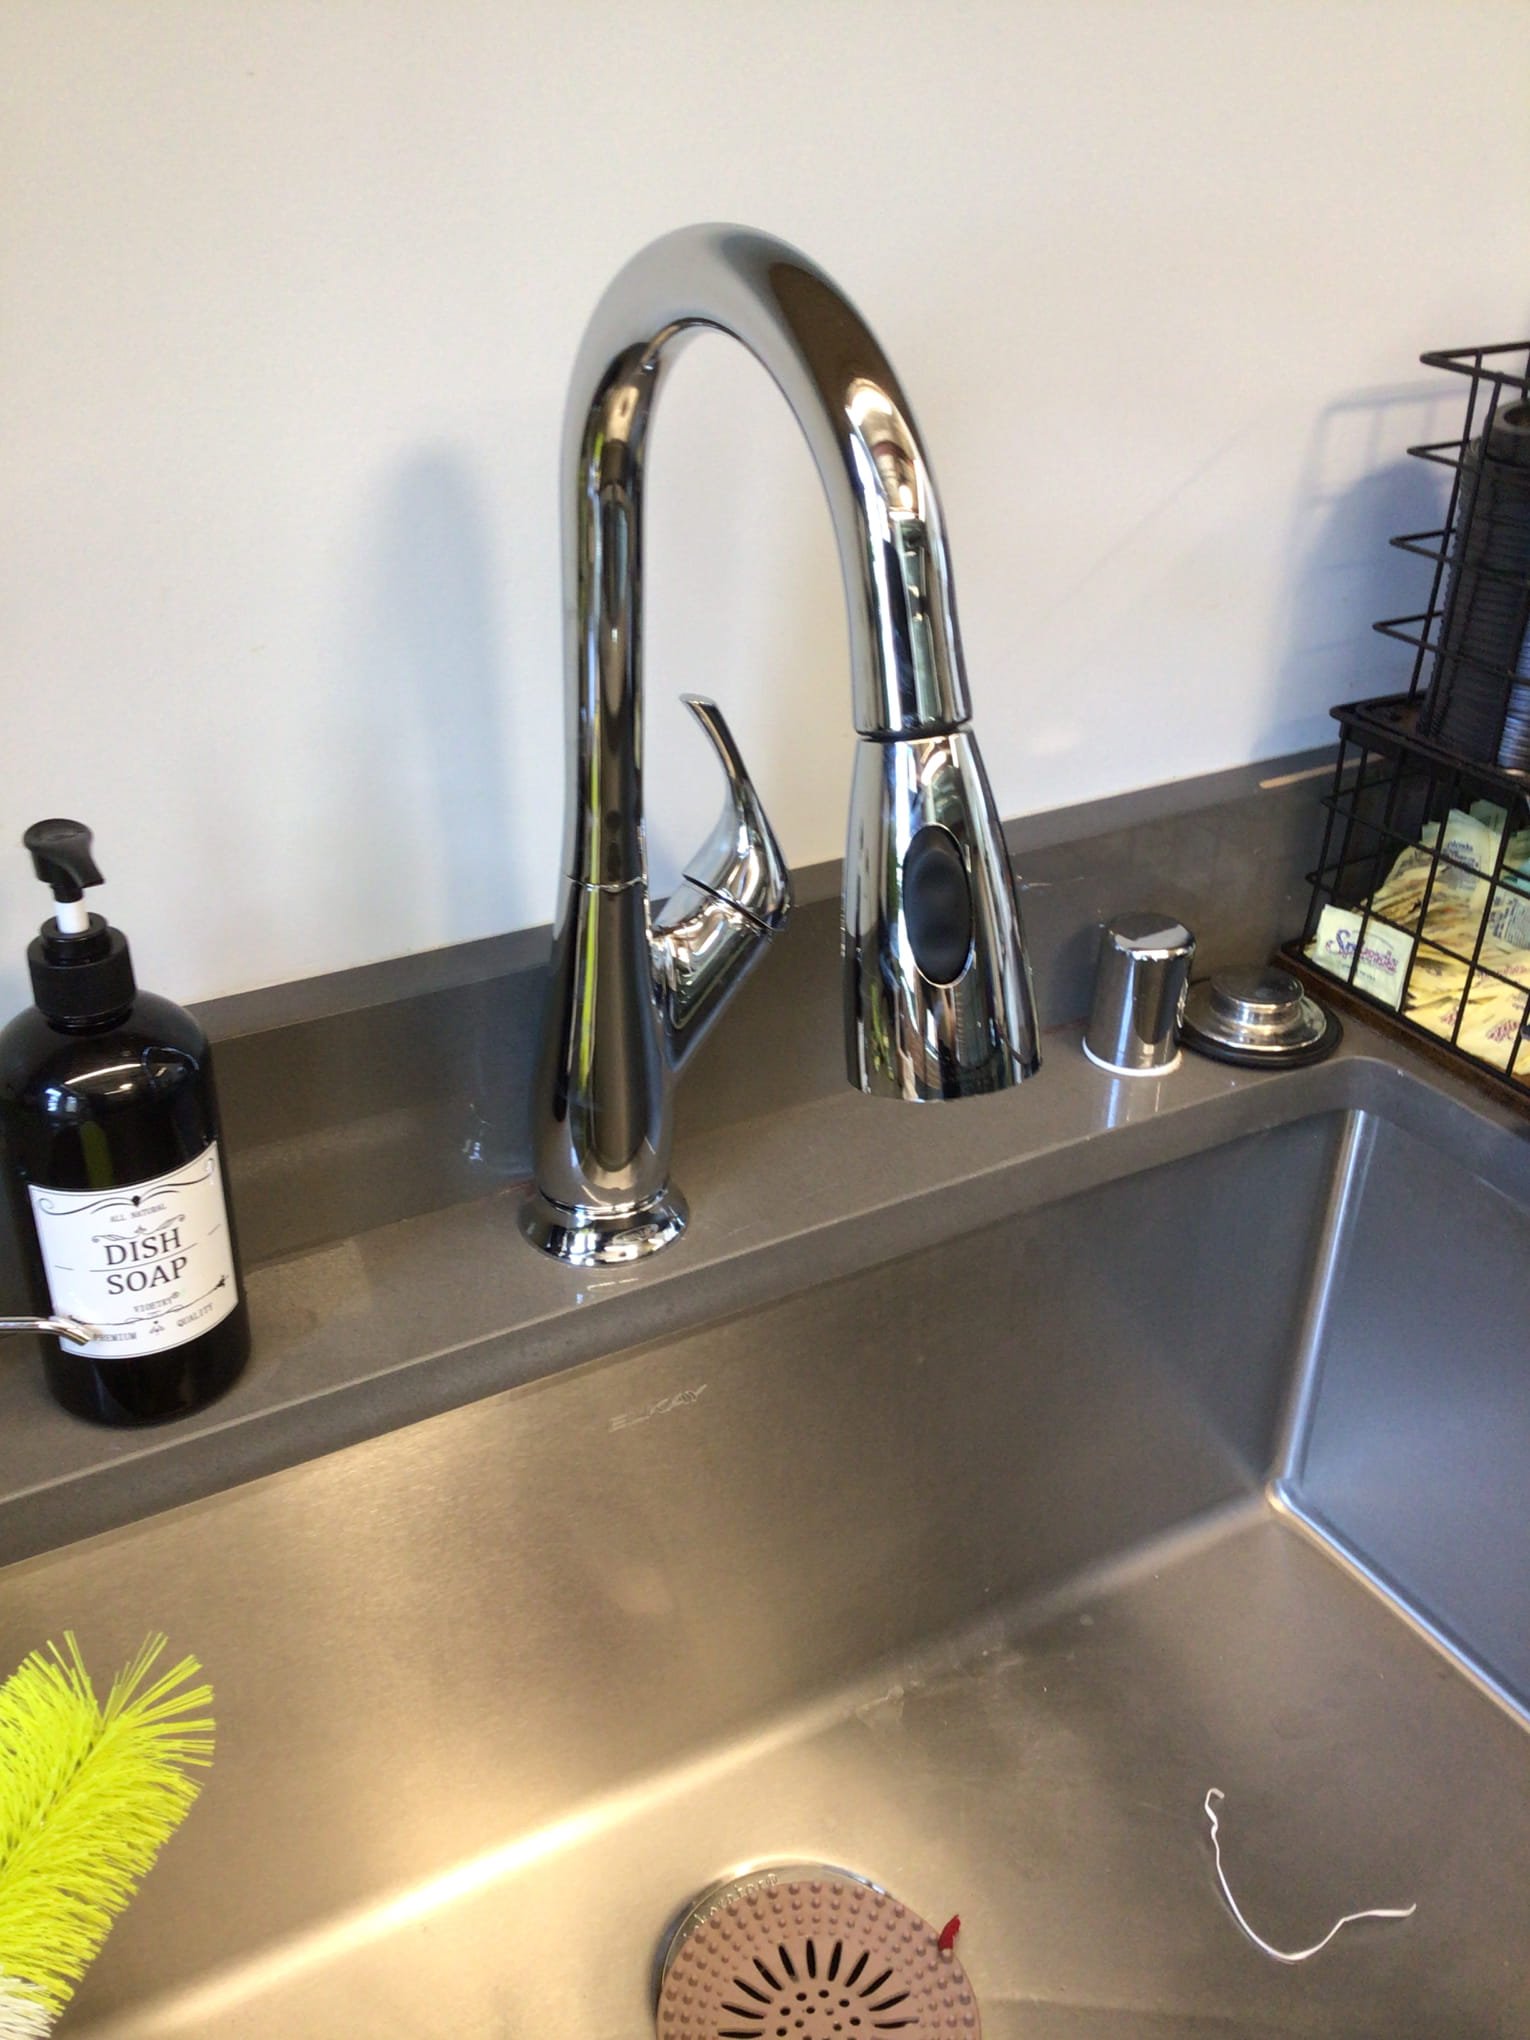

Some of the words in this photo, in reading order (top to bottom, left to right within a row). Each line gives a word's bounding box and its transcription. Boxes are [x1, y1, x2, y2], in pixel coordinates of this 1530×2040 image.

[103, 1226, 181, 1266] DISH
[106, 1256, 188, 1295] SOAP
[176, 1302, 214, 1328] QUALITY
